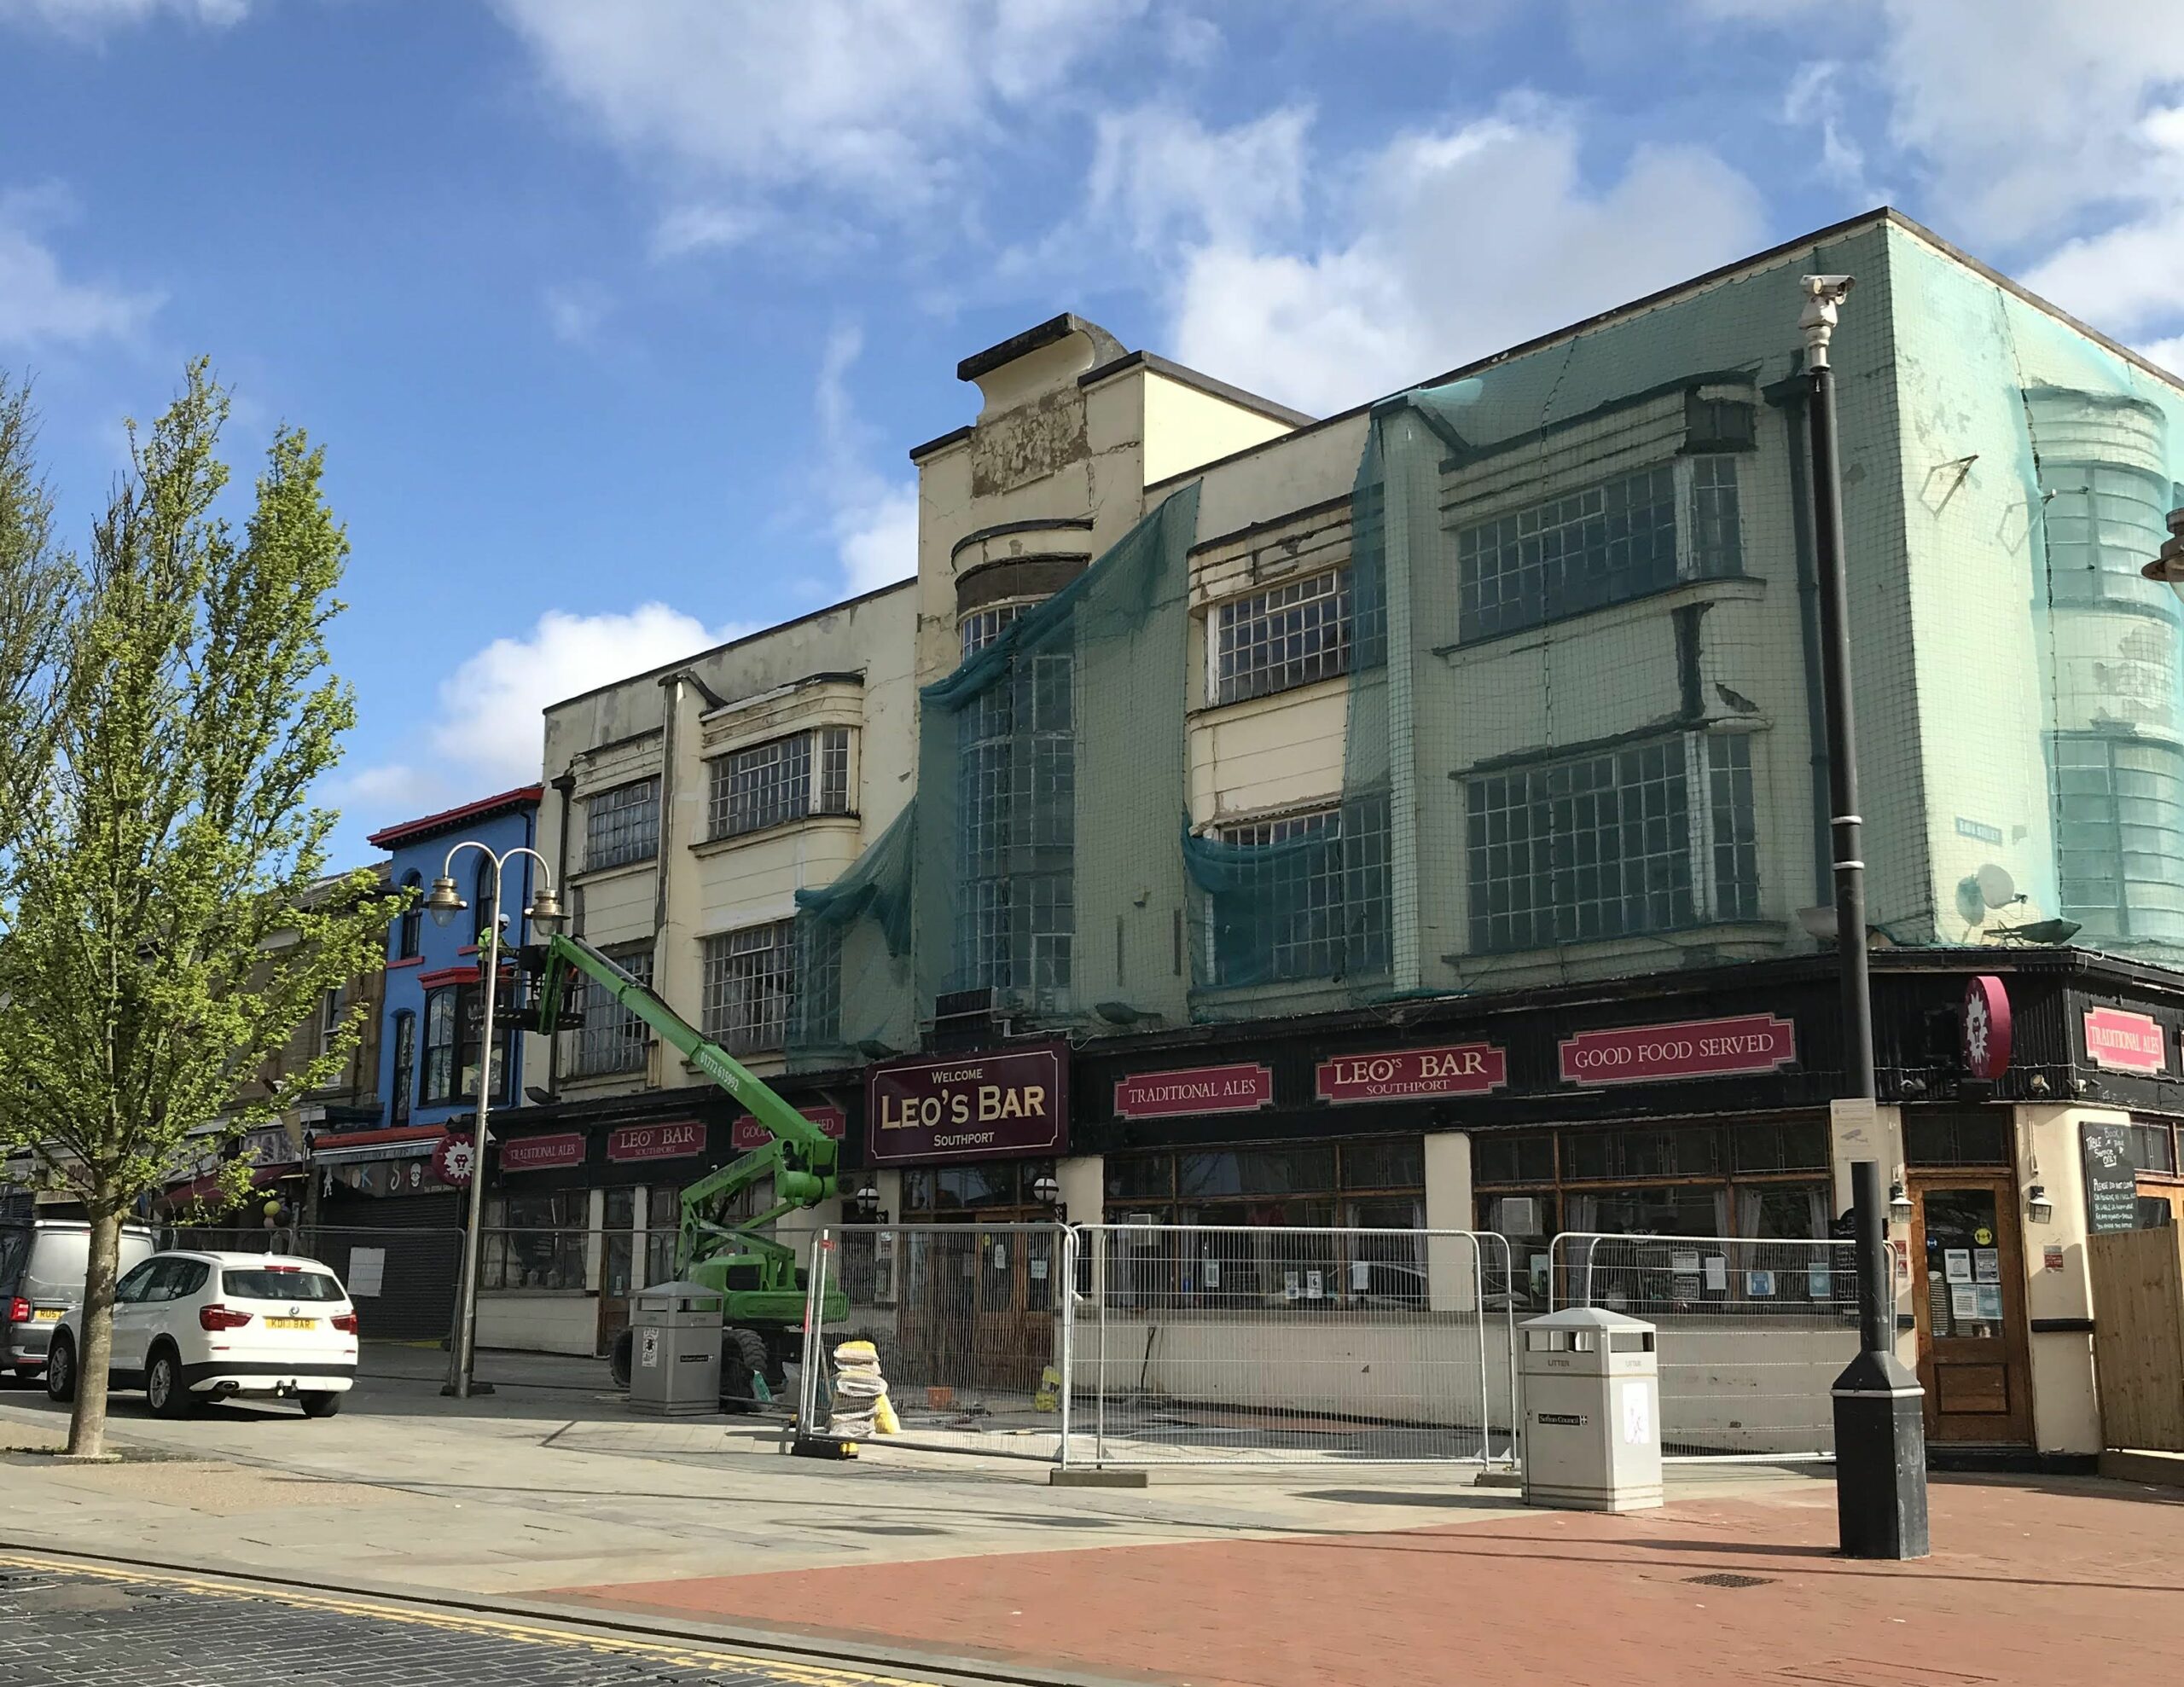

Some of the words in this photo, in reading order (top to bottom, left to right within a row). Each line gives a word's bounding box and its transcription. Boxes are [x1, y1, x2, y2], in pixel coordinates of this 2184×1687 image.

[2089, 1026, 2141, 1052] TRADITIONAL
[2142, 1035, 2160, 1055] ALES
[1575, 1046, 1632, 1069] GOOD
[1637, 1041, 1693, 1063] FOOD
[1699, 1034, 1774, 1057] SERVED
[932, 1069, 984, 1084] WELCOME
[1333, 1058, 1403, 1085] LEO'S
[1419, 1052, 1488, 1078] BAR
[1128, 1082, 1219, 1104] TRADITIONAL
[1223, 1079, 1257, 1097] ALES
[1365, 1079, 1450, 1096] SOUTHPORT
[978, 1085, 1047, 1122] BAR
[662, 1127, 695, 1145] BAR
[933, 1132, 996, 1147] SOUTHPORT
[510, 1145, 556, 1161] TRADITIONAL
[558, 1144, 577, 1157] ALES
[634, 1145, 677, 1157] SOUTHPORT
[1547, 1359, 1570, 1367] LITTER
[1558, 1416, 1579, 1425] Council
